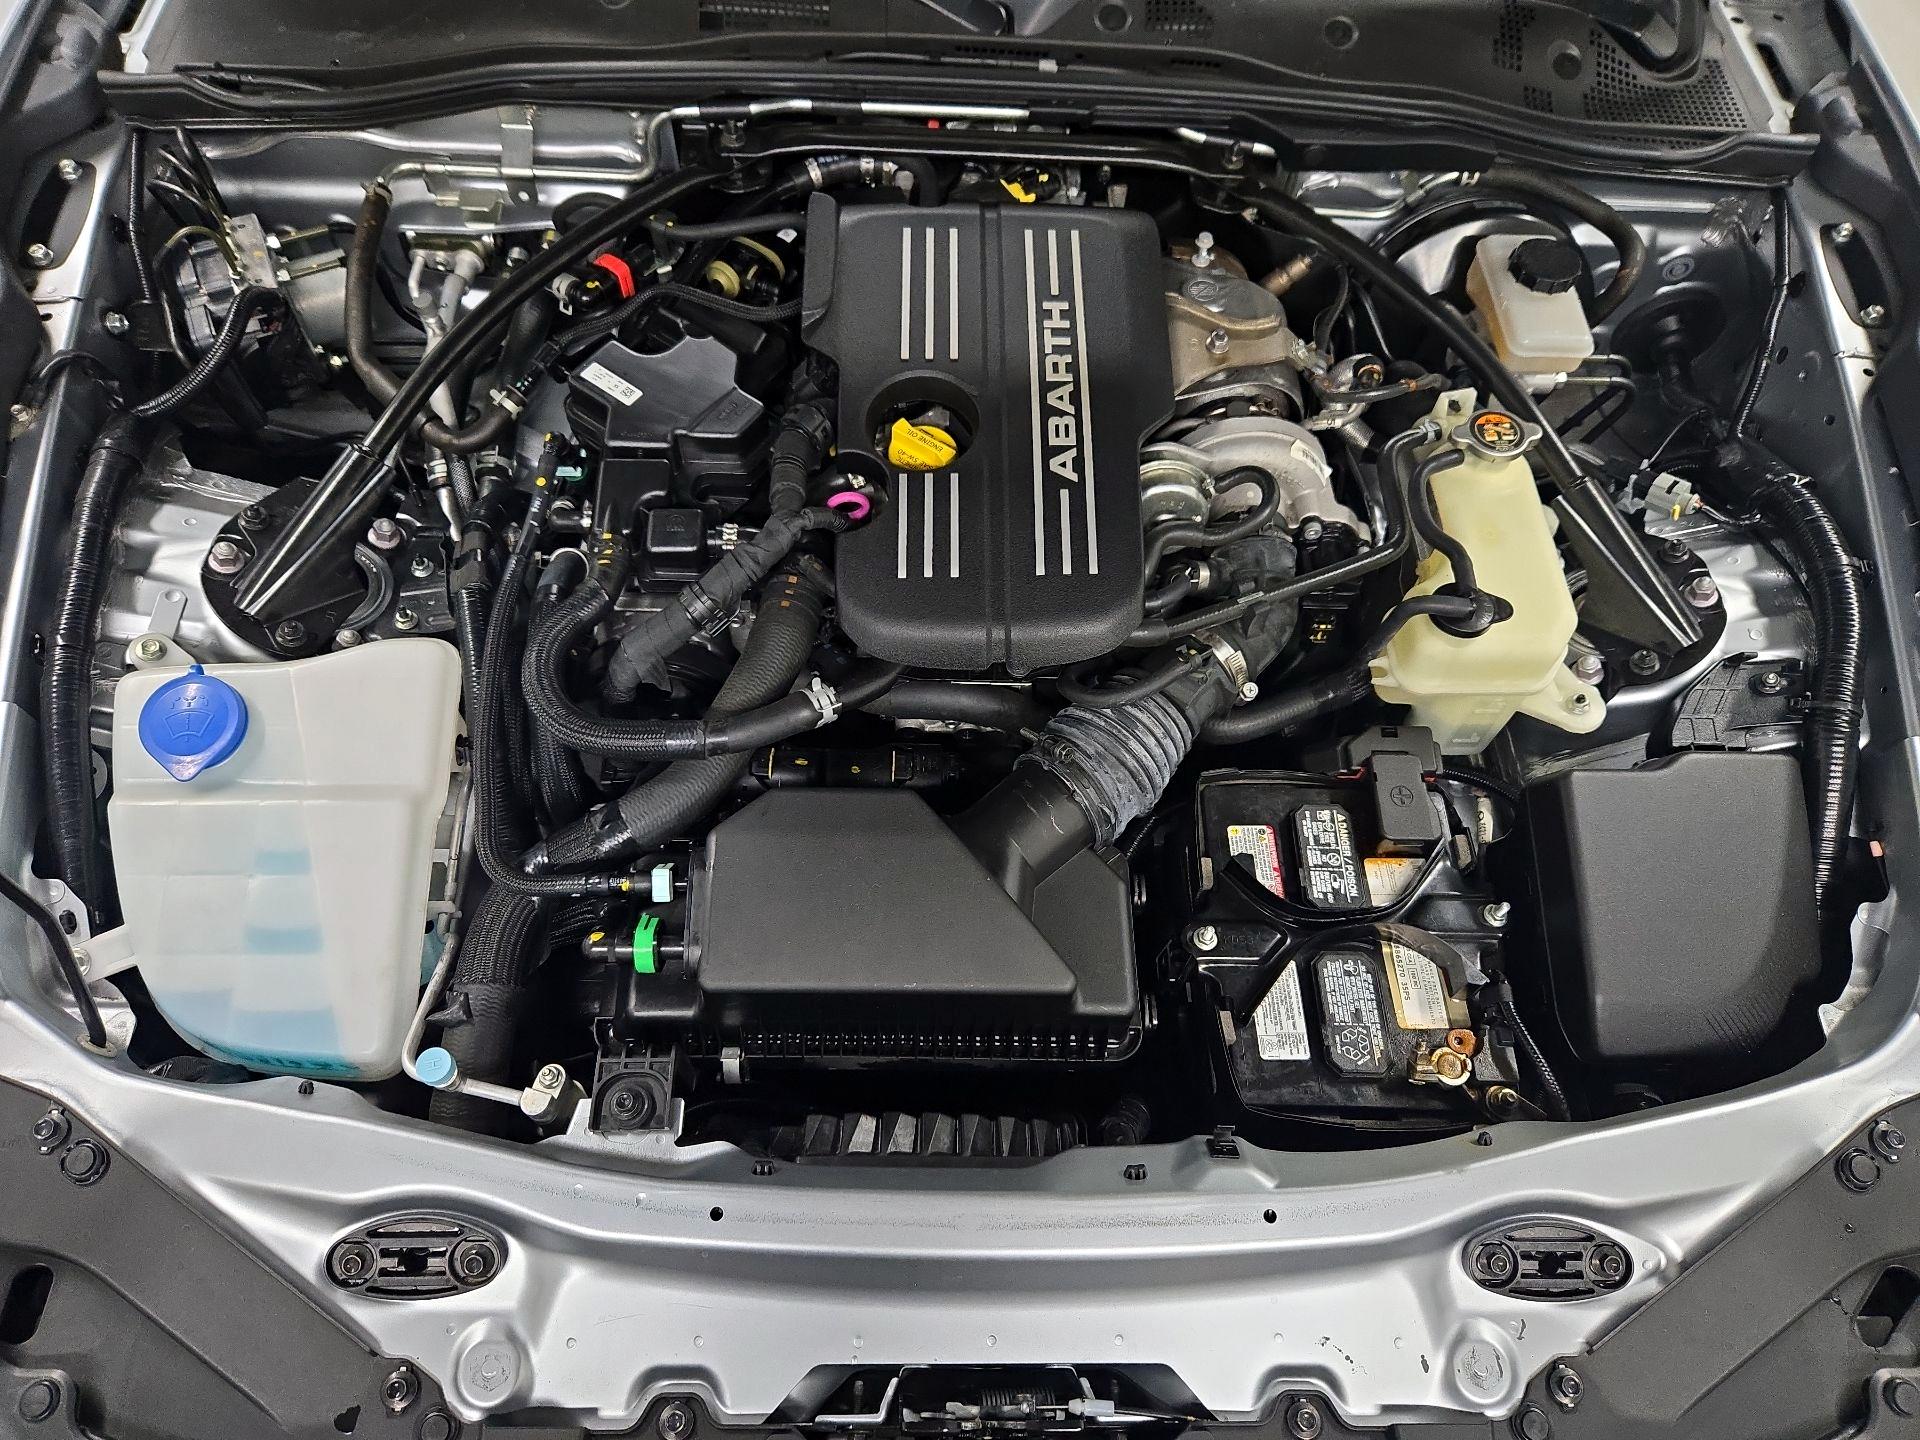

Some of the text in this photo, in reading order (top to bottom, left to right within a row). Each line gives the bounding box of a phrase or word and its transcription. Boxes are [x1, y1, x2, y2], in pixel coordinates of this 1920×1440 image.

[1043, 302, 1078, 482] ABARTH
[906, 428, 944, 453] ENGINE OIL
[897, 448, 919, 463] 5W-40
[1337, 821, 1351, 857] DANGER
[1344, 864, 1358, 897] POISON
[1400, 981, 1410, 1001] 35PS
